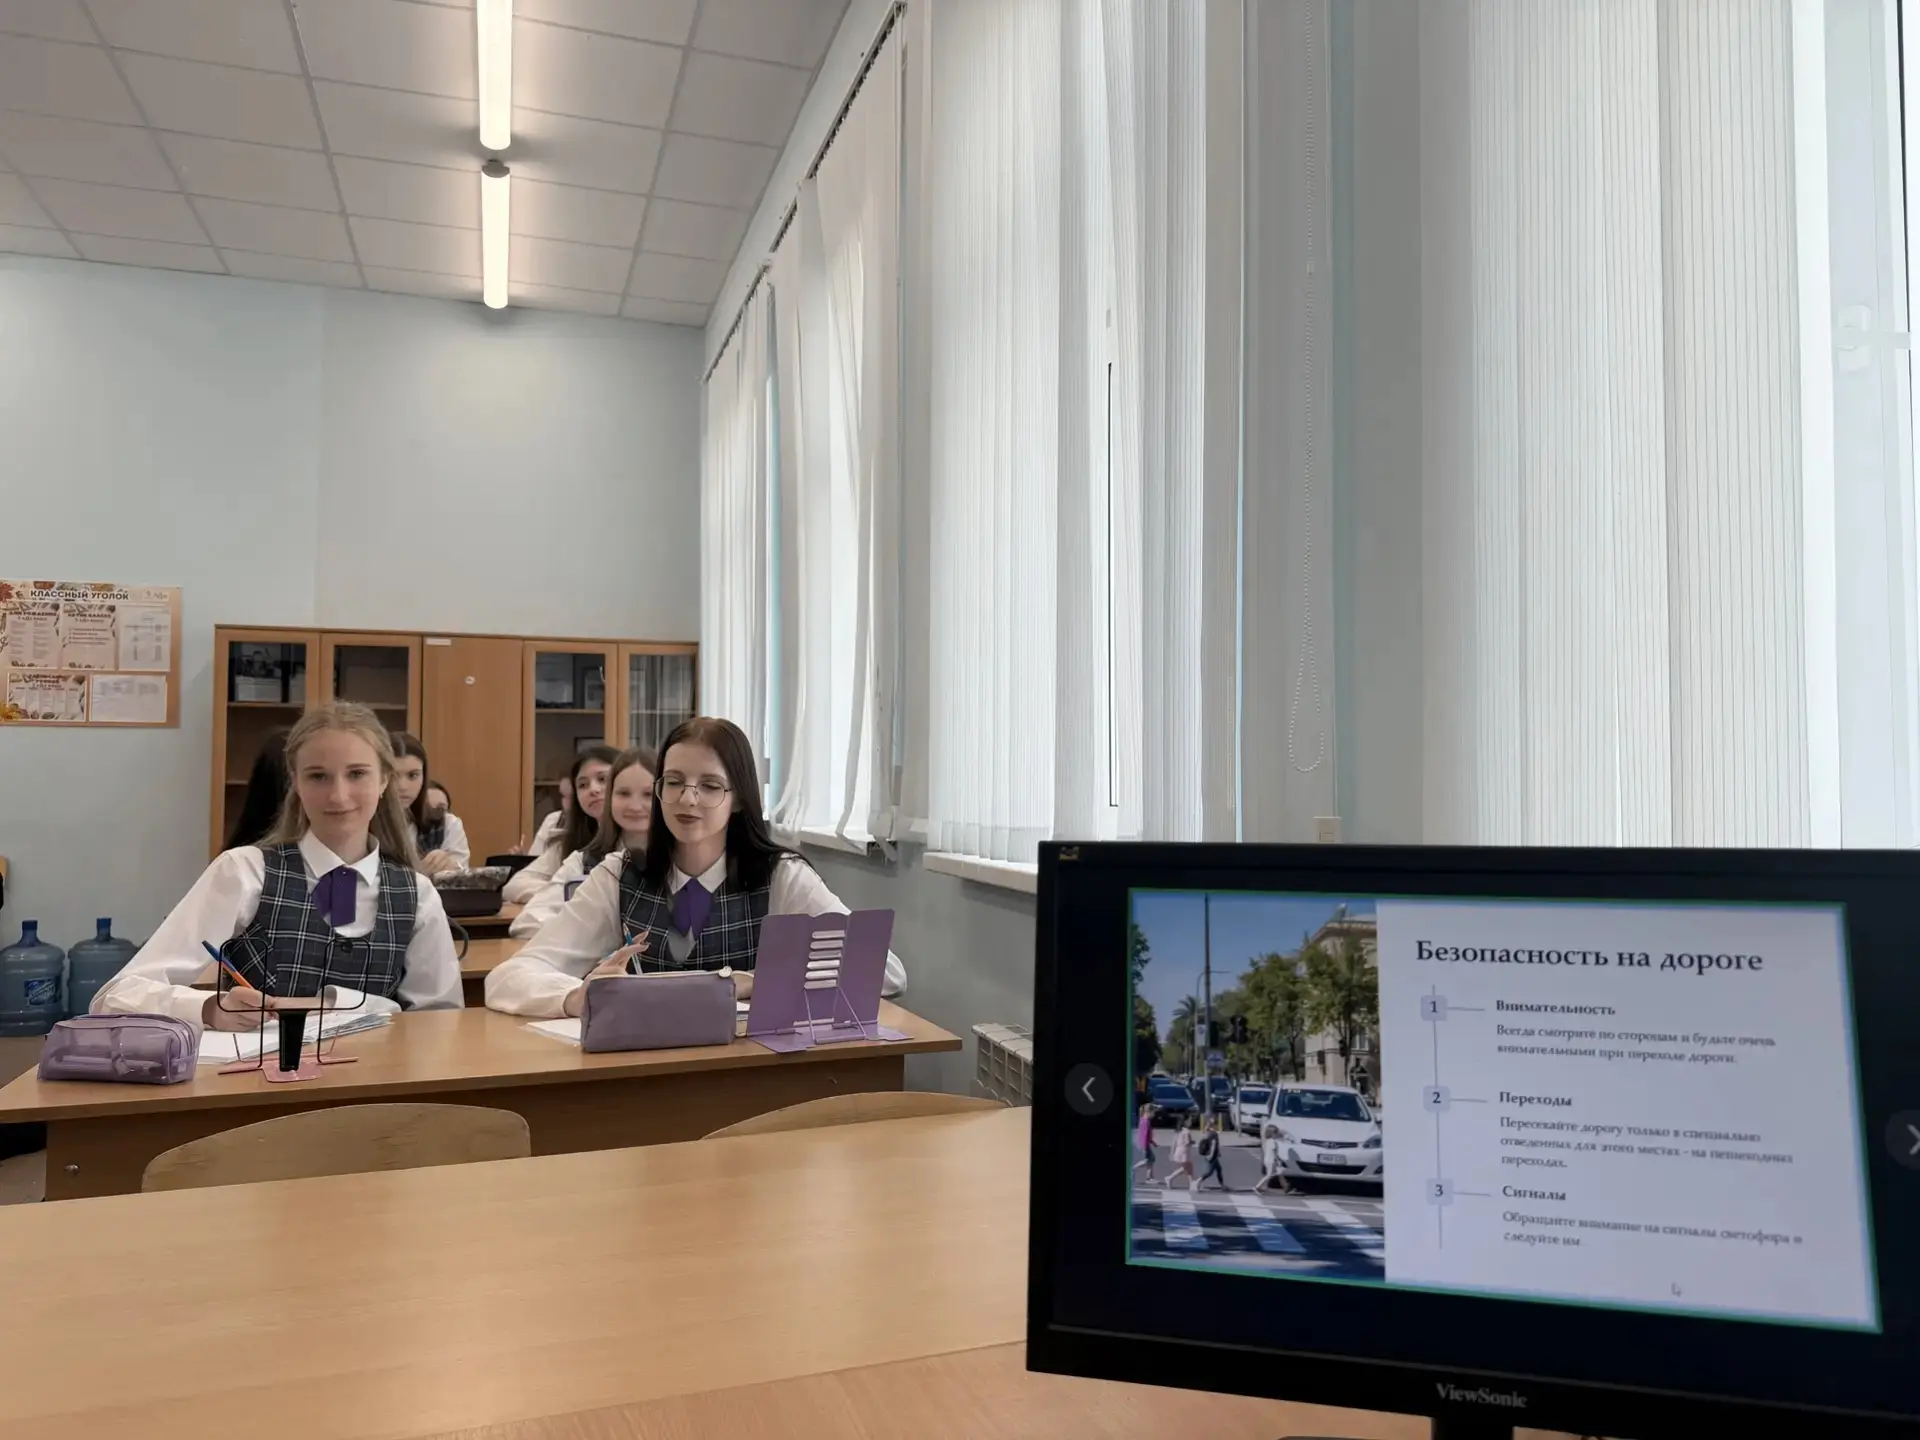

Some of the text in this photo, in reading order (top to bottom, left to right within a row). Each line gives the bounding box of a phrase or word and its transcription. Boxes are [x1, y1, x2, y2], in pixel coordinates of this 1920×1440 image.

[30, 590, 129, 600] КЛАССНЫЙ УГОЛОК
[1416, 940, 1763, 976] Безопасность на дороге
[1430, 1001, 1438, 1013] 1
[1496, 1000, 1616, 1015] Внимательность
[1497, 1024, 1535, 1036] Всегда
[1538, 1028, 1596, 1041] смотрите
[1599, 1031, 1615, 1040] по
[1617, 1032, 1677, 1045] сторонам
[1681, 1033, 1690, 1042] и
[1738, 1036, 1776, 1046] очень
[1497, 1045, 1595, 1057] внимательными
[1599, 1049, 1624, 1061] при
[1628, 1051, 1685, 1063] переходе
[1432, 1092, 1441, 1104] 2
[1500, 1092, 1572, 1107] Переходы
[1500, 1116, 1761, 1143] Пересекайте дорогу только в специально
[1500, 1138, 1571, 1150] отведенных
[1574, 1142, 1597, 1152] для
[1601, 1143, 1634, 1154] этого
[1637, 1146, 1681, 1157] местах
[1691, 1149, 1707, 1158] на
[1501, 1156, 1568, 1169] переходах.
[1435, 1185, 1444, 1197] 3
[1502, 1185, 1567, 1201] Сигналы
[1502, 1211, 1576, 1226] Обращайте
[1578, 1219, 1642, 1232] внимание
[1644, 1224, 1660, 1234] на
[1662, 1225, 1717, 1238] сигналы
[1720, 1228, 1790, 1246] светофора
[1503, 1231, 1560, 1246] следуйте
[1435, 1382, 1528, 1408] ViewSonic
